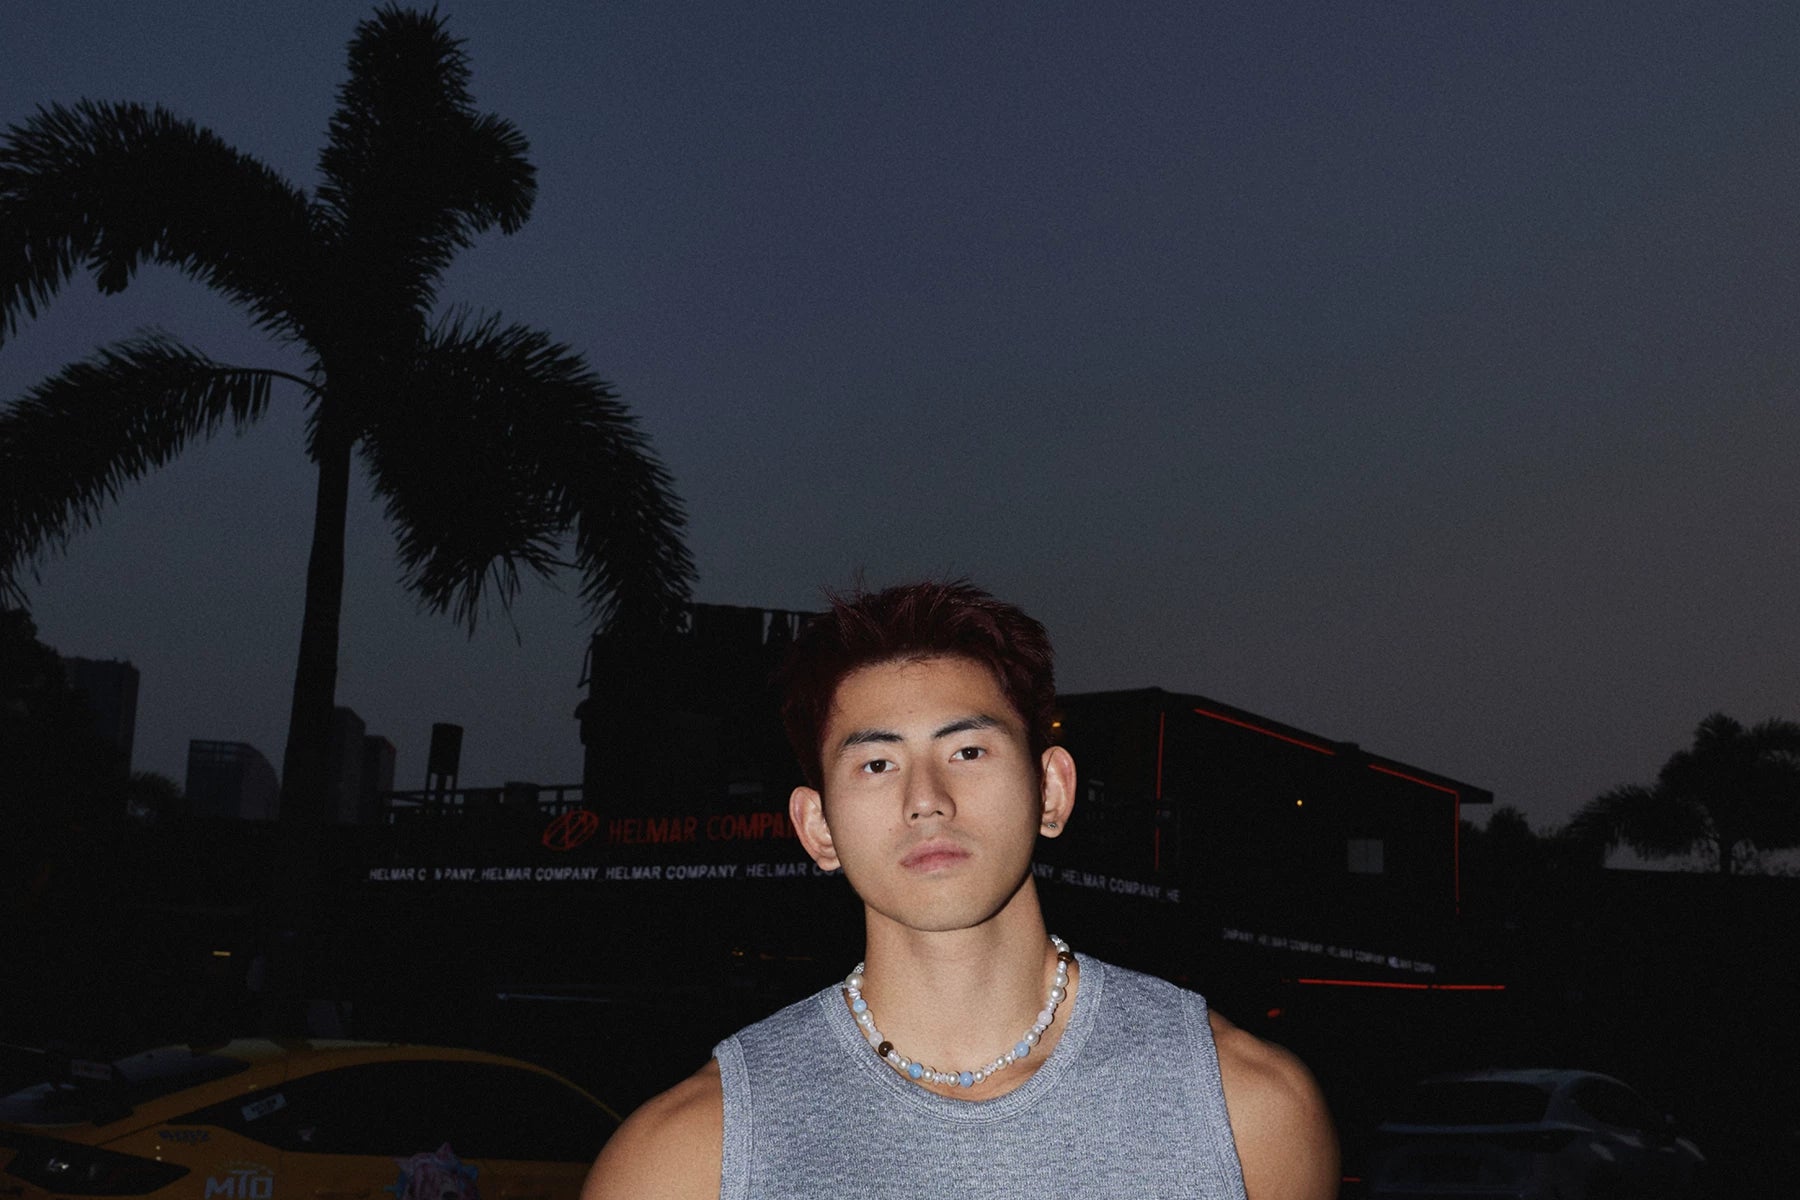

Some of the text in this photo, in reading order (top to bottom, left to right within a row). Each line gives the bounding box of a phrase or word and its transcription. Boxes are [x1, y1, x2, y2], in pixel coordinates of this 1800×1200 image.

[608, 815, 698, 845] HELMAR
[368, 866, 416, 881] HELMAR
[480, 866, 531, 881] HELMAR
[534, 866, 600, 881] COMPANY
[605, 865, 661, 880] HELMAR
[665, 864, 738, 880] COMPANY
[745, 861, 808, 878] HELMAR
[1060, 868, 1106, 890] HELMAR
[1108, 877, 1162, 899] COMPANY
